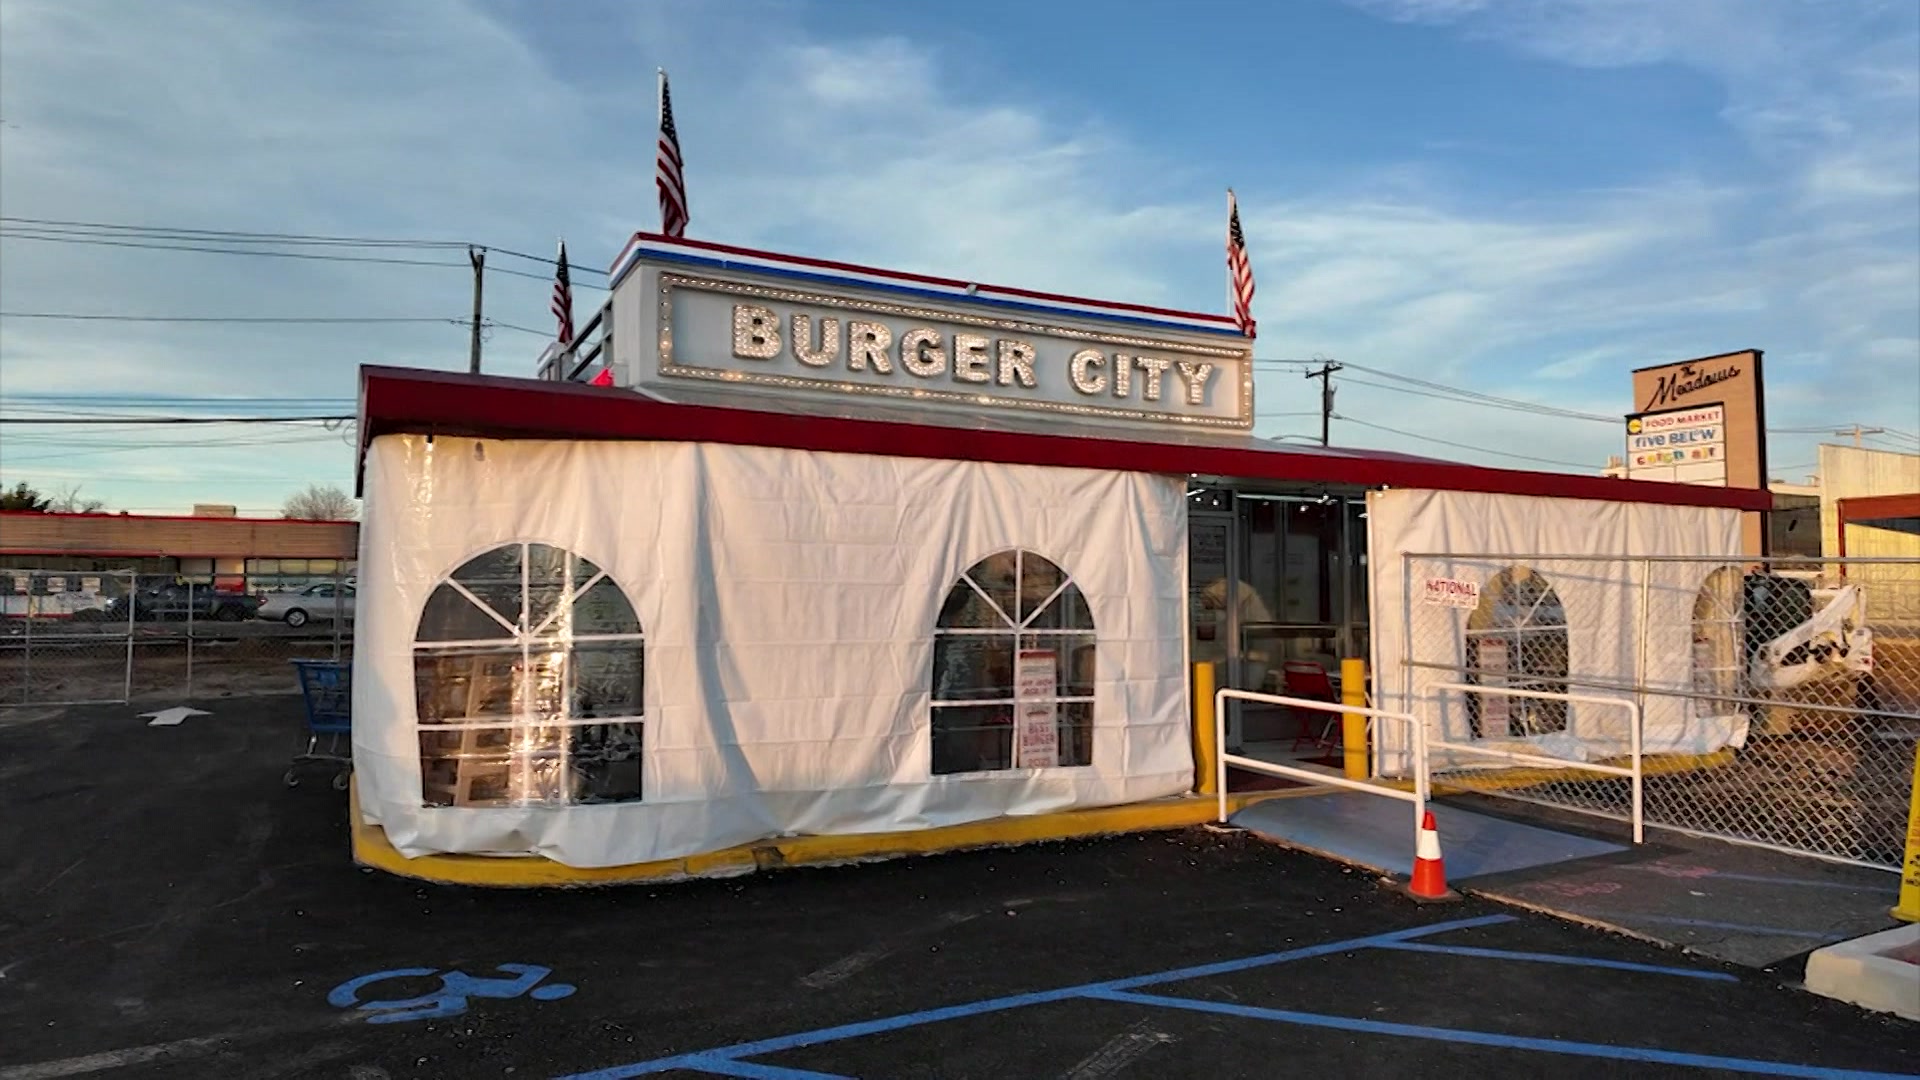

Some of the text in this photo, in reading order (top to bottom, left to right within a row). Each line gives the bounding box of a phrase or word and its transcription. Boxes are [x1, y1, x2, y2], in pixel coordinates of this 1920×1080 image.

[731, 304, 1213, 405] BURGER CITY
[1644, 365, 1741, 411] Meadows
[1645, 411, 1720, 428] FOOD MARKET
[1635, 434, 1666, 447] five
[1426, 580, 1477, 597] NATIONAL
